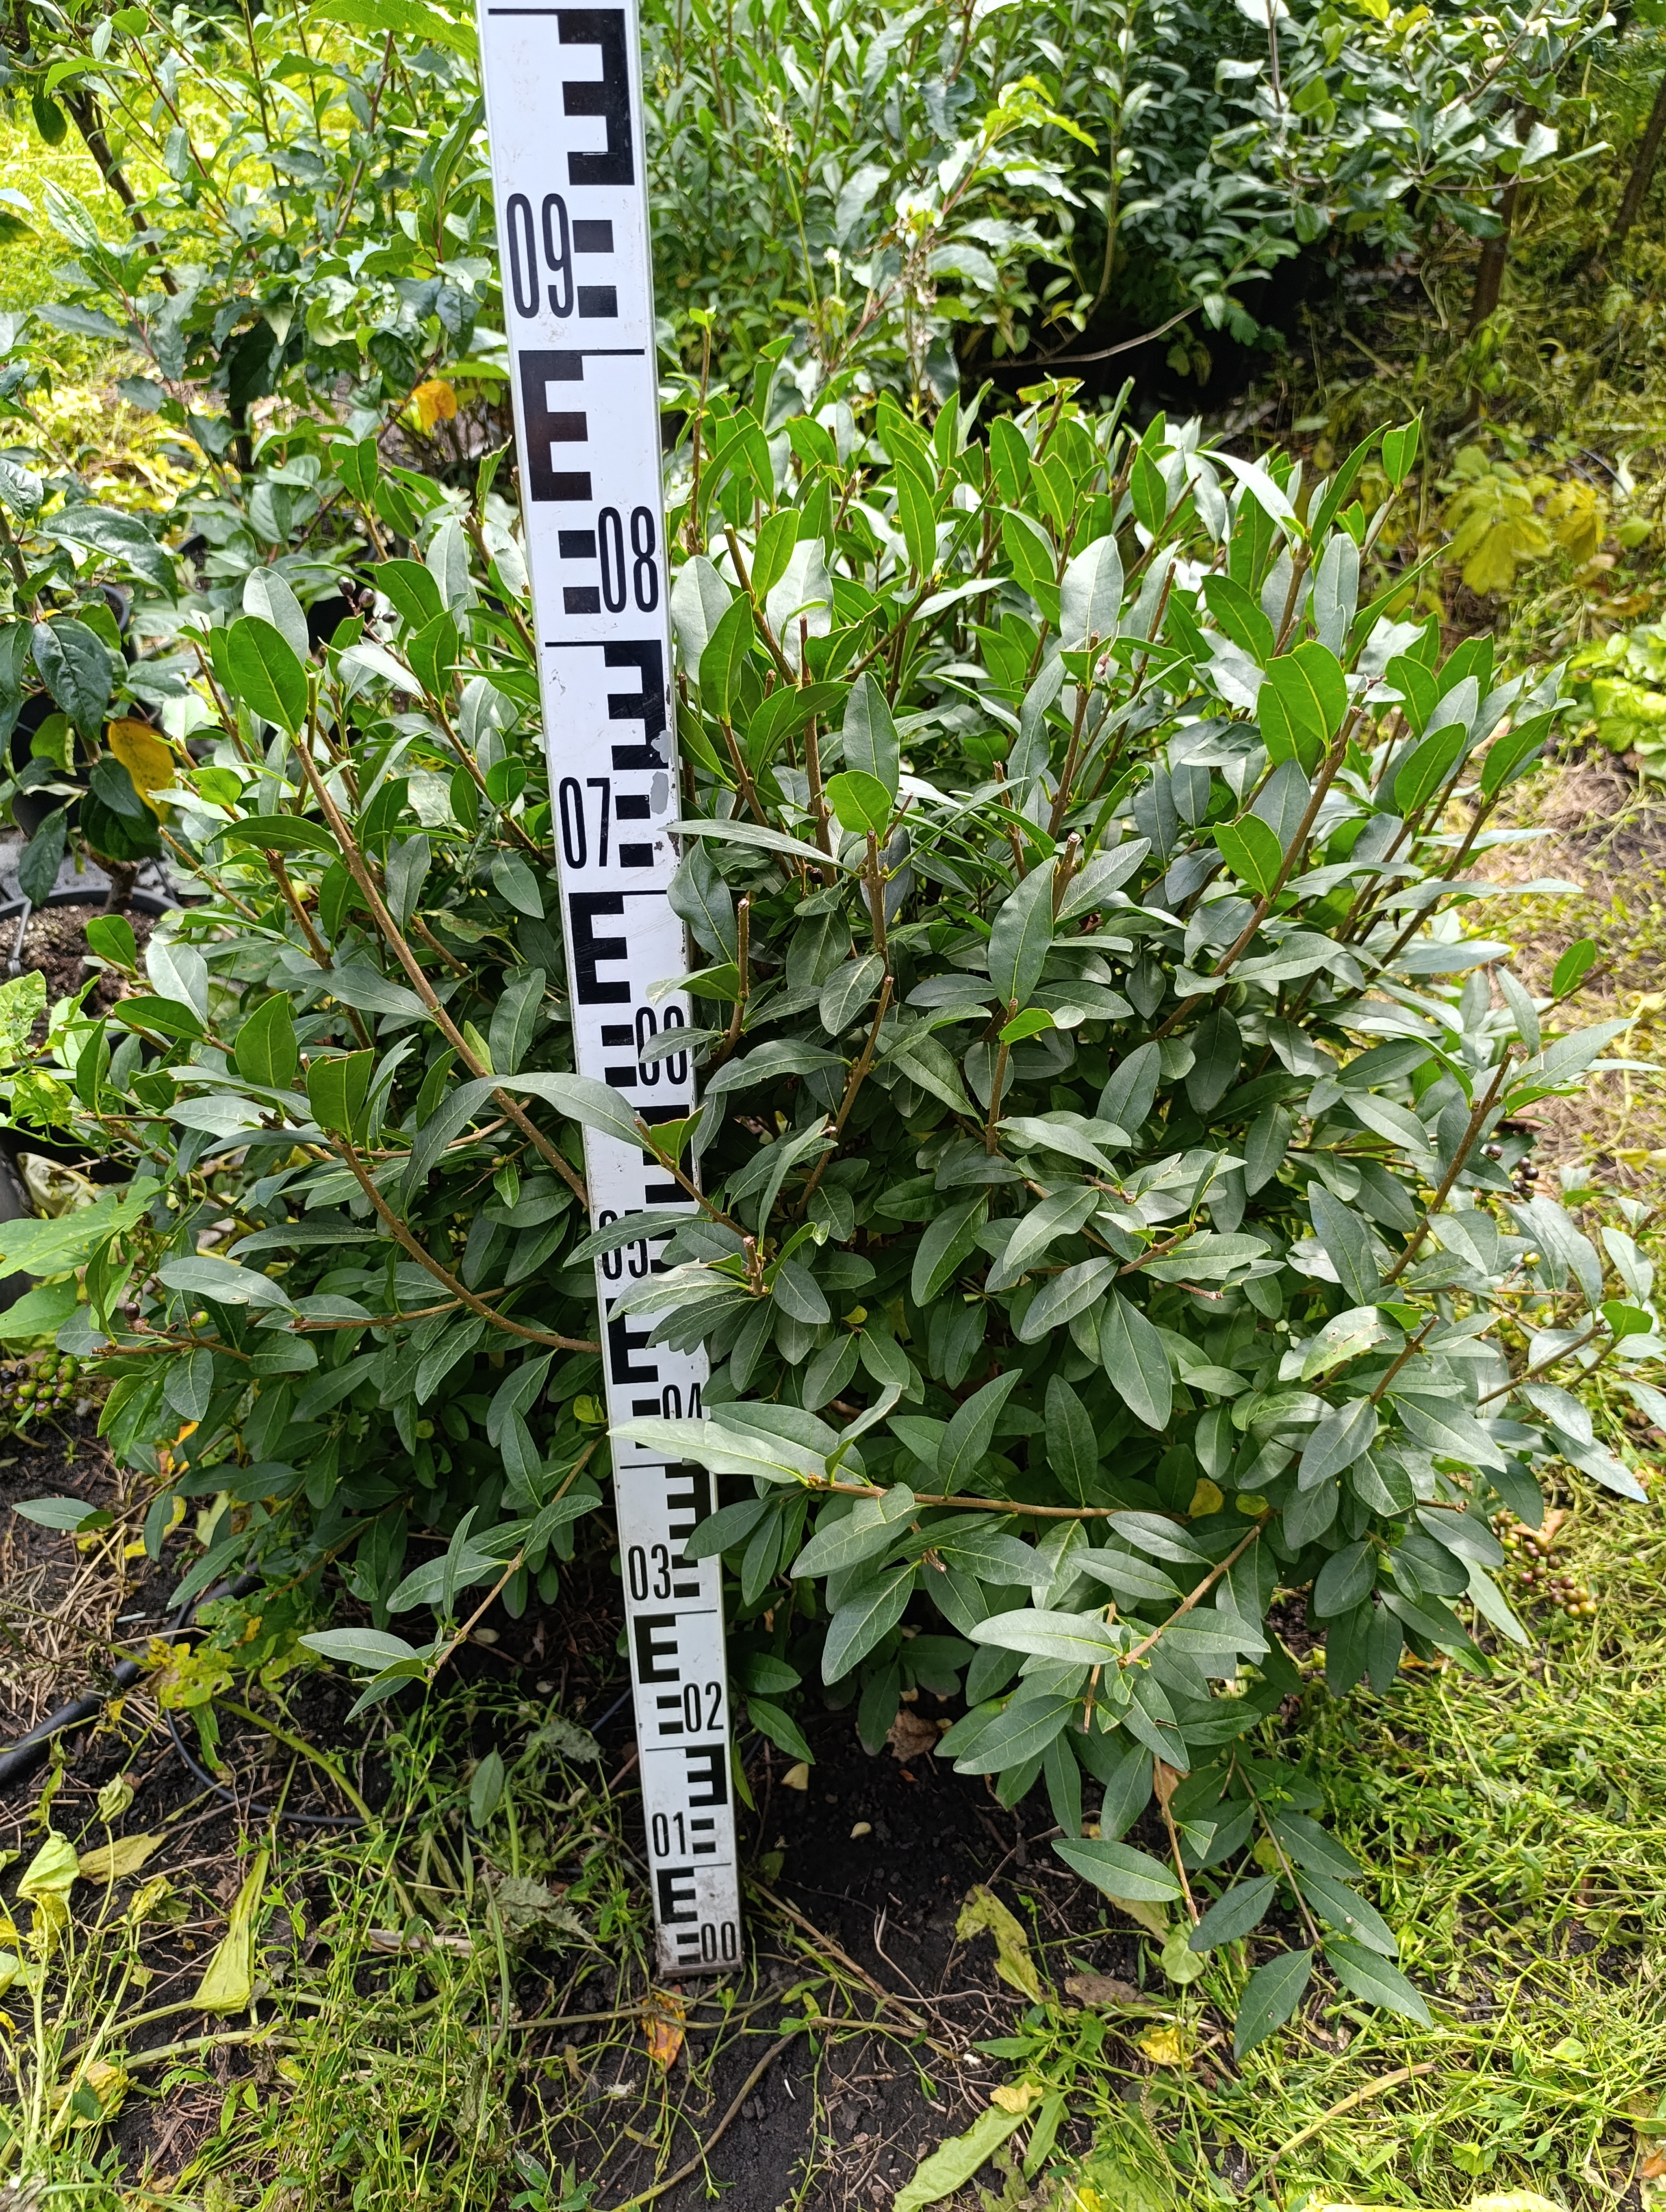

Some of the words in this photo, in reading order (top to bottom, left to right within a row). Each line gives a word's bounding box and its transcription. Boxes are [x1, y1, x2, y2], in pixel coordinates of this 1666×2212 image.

[507, 193, 574, 318] 09
[598, 506, 658, 613] 08
[559, 777, 610, 869] 07
[628, 1544, 671, 1601] 03
[683, 1681, 724, 1732] 02
[652, 1811, 686, 1857] 01
[700, 1921, 736, 1963] 00
